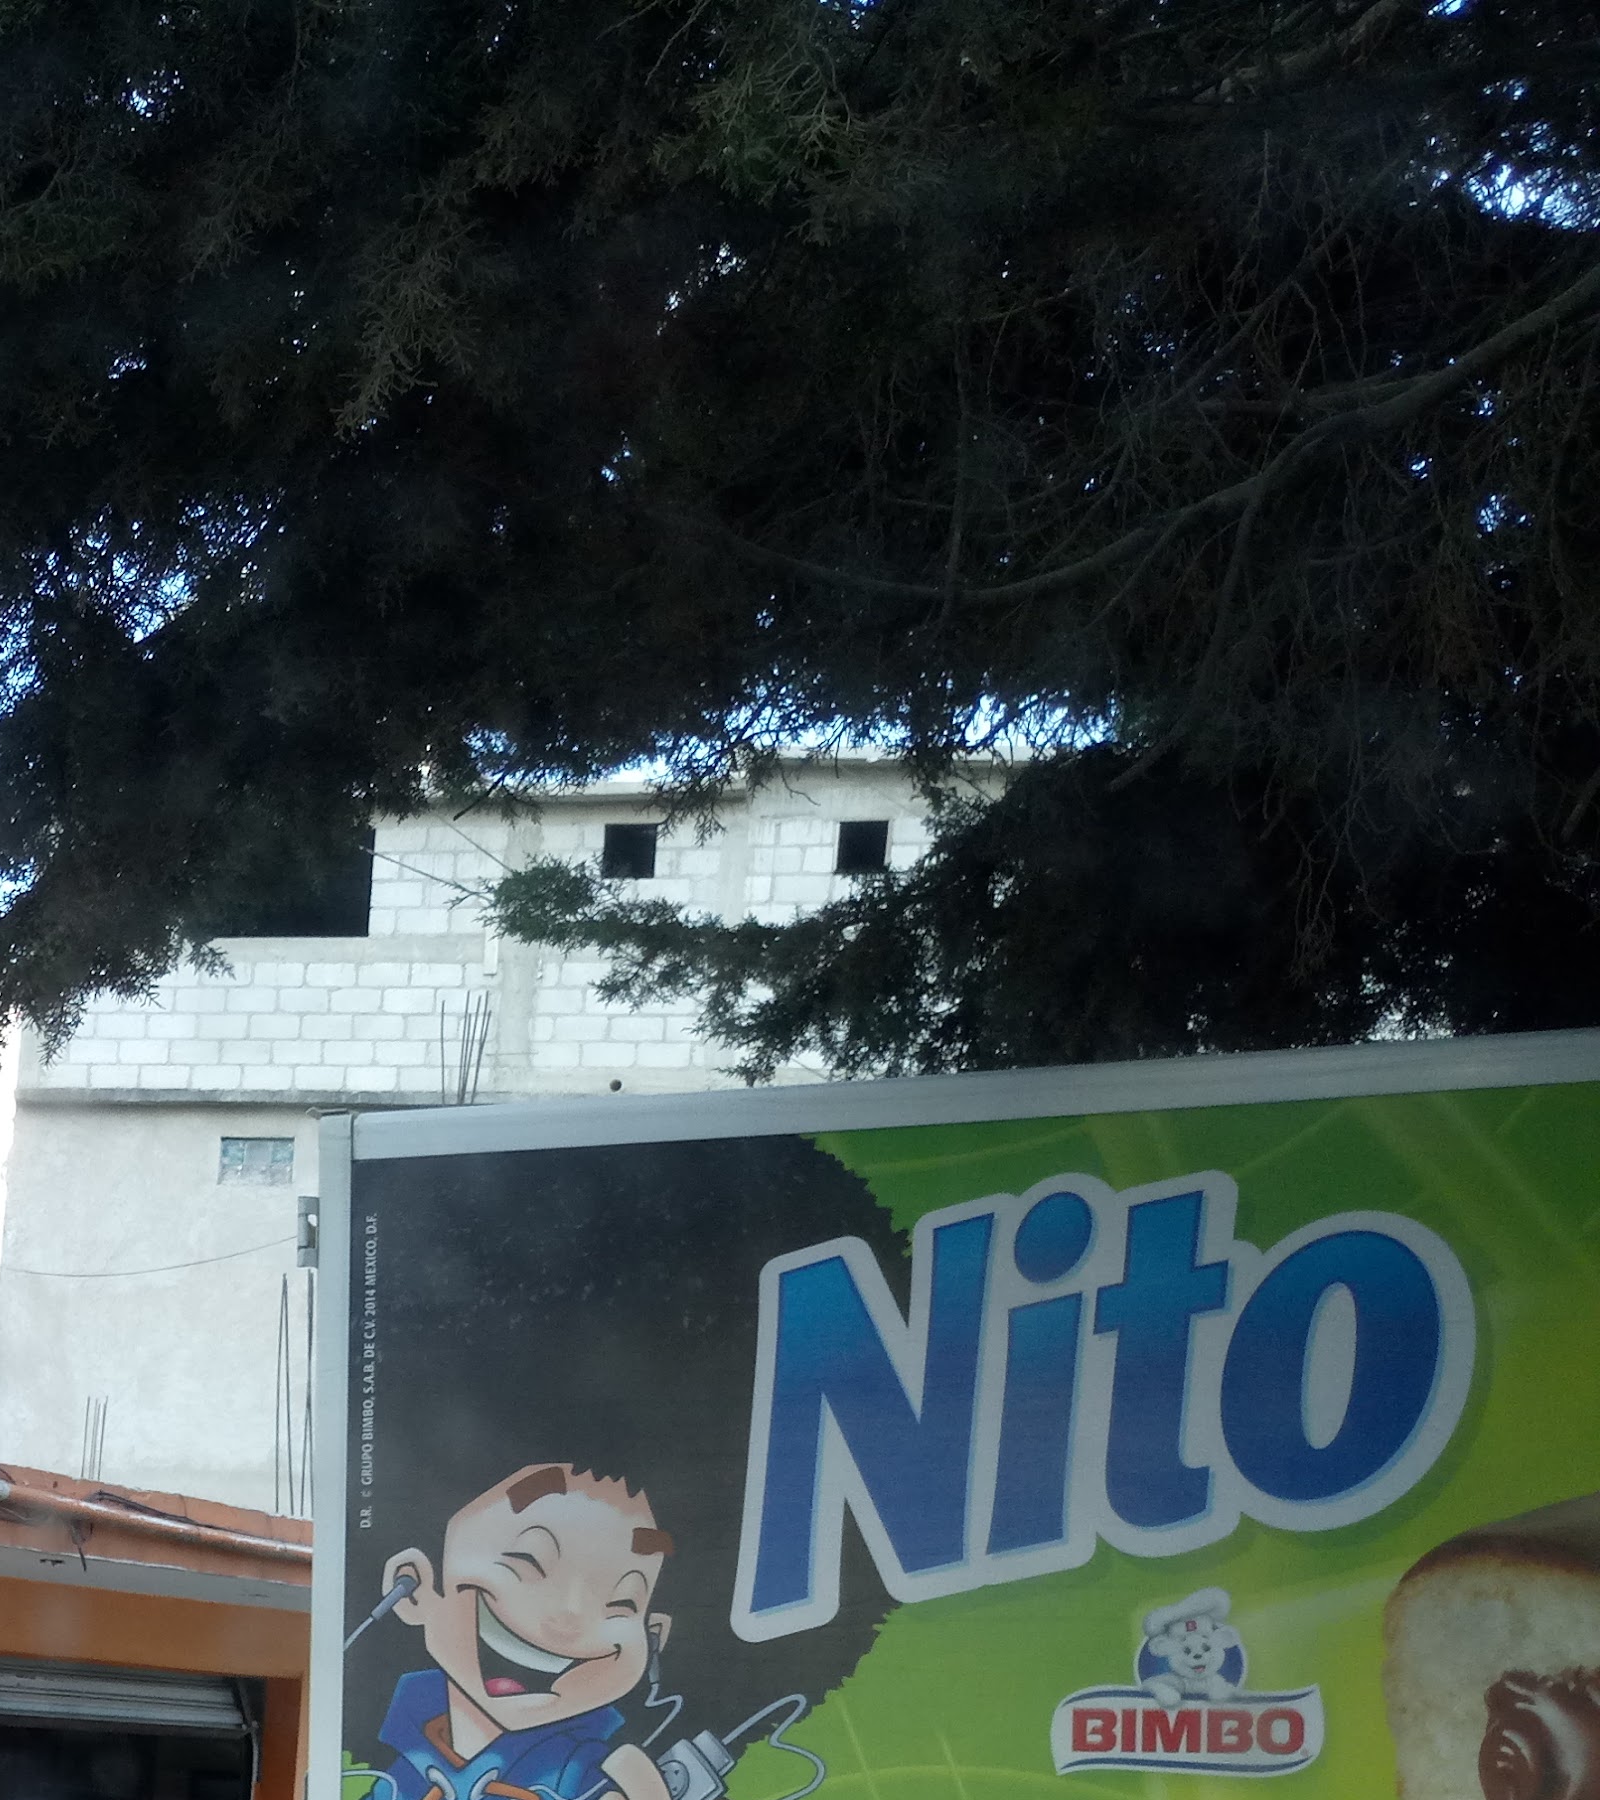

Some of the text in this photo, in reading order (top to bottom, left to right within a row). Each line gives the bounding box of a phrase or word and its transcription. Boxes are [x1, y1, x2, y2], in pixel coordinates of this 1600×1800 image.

[364, 1289, 376, 1316] 2014
[363, 1343, 375, 1358] DE
[730, 1170, 1476, 1642] Nito
[361, 1443, 374, 1485] GRUPO
[1071, 1708, 1305, 1756] BIMBO
